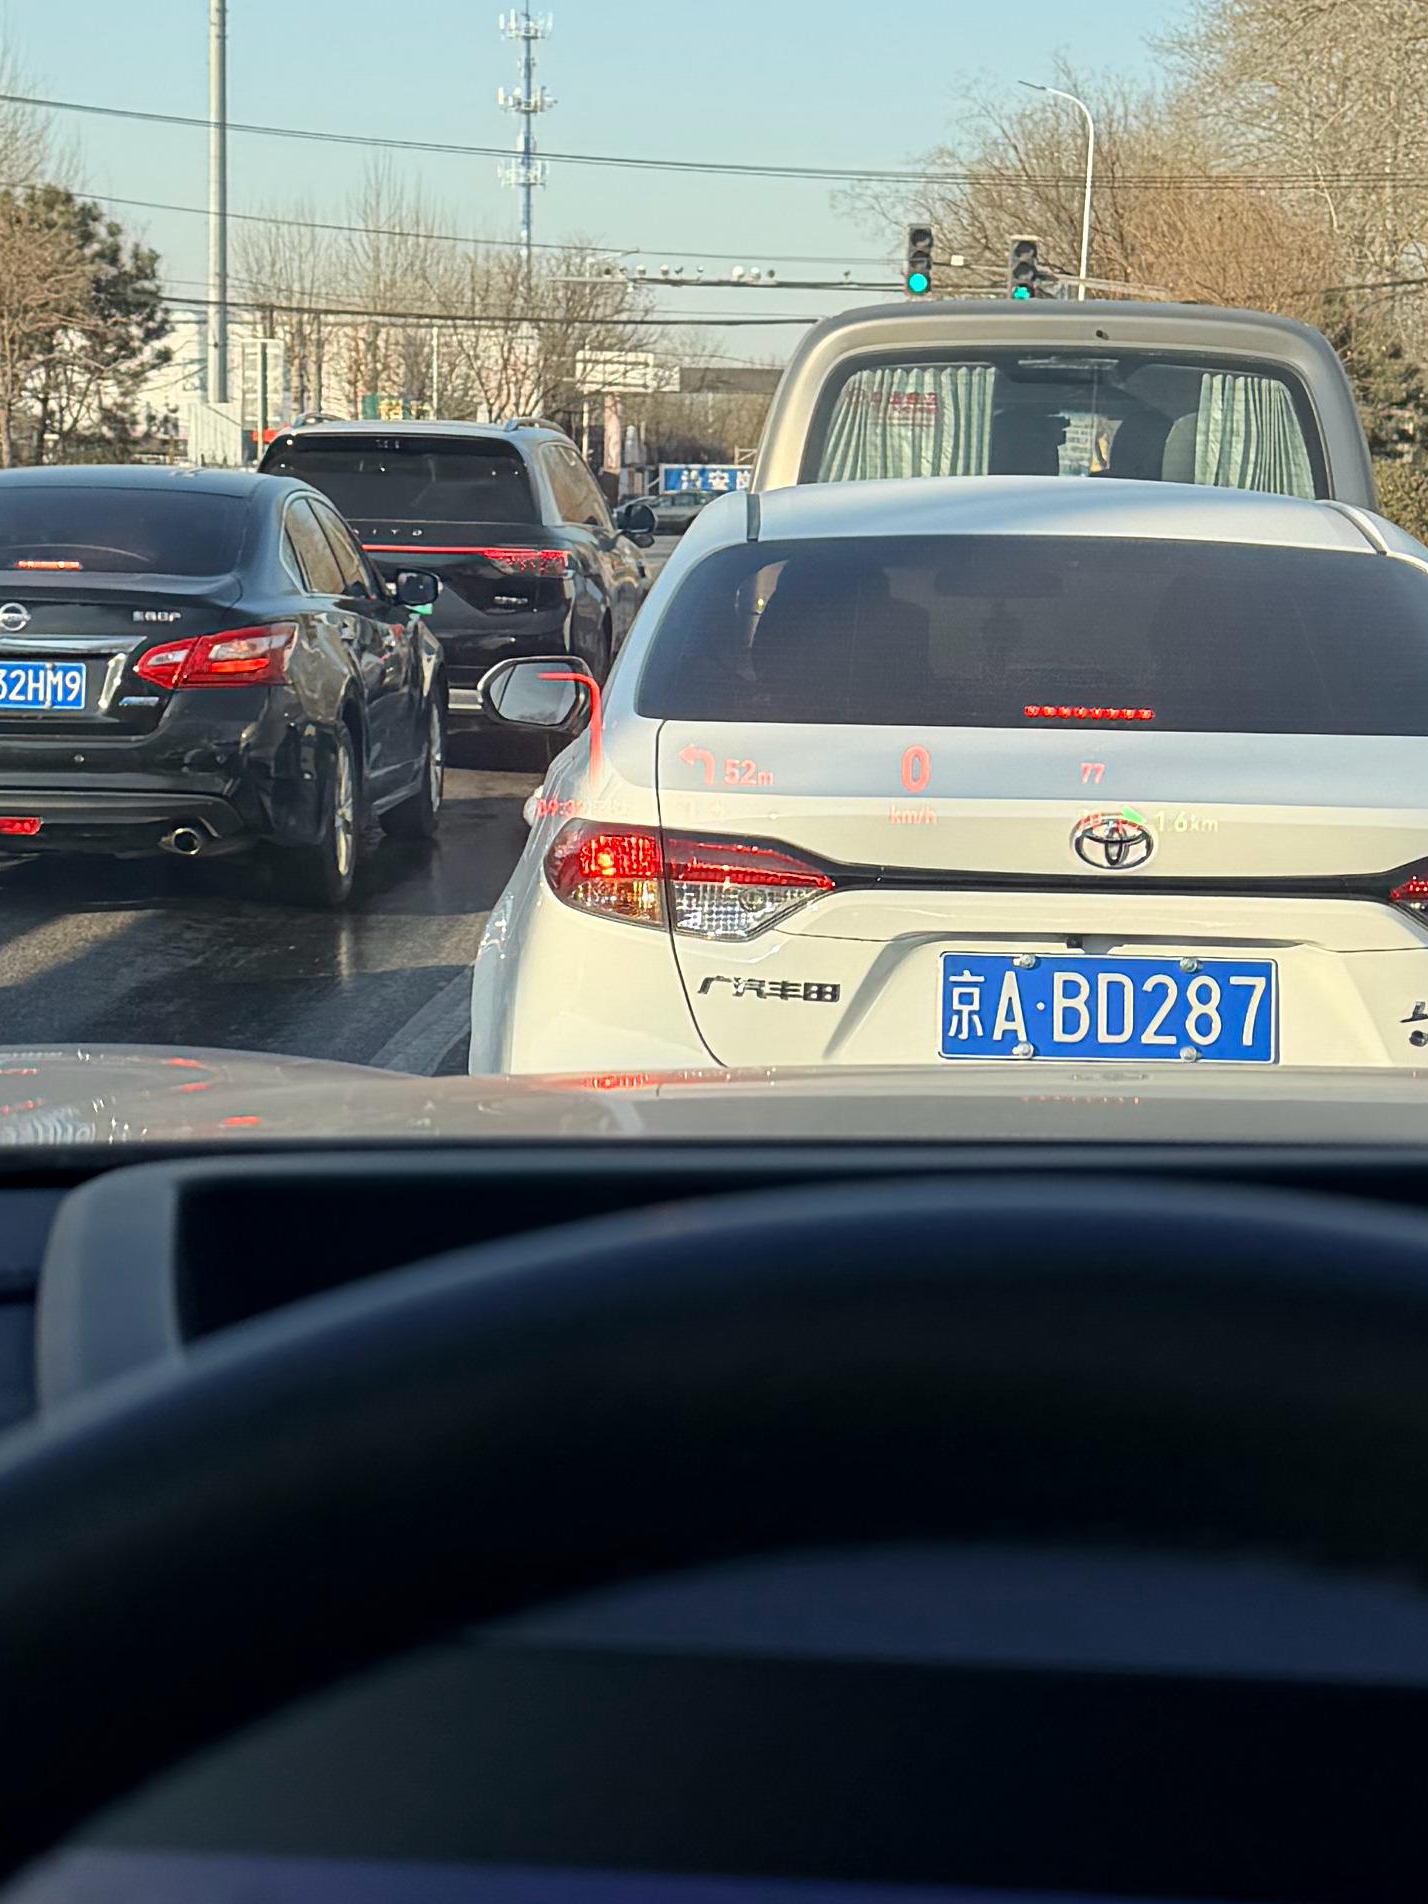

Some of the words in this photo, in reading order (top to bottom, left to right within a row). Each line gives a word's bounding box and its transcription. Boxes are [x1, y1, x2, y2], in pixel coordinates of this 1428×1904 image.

[899, 744, 931, 794] 0
[1080, 762, 1106, 785] 77
[888, 806, 937, 825] km/h
[697, 974, 841, 1003] 广汽丰田
[947, 969, 1268, 1048] 京A·BD287
